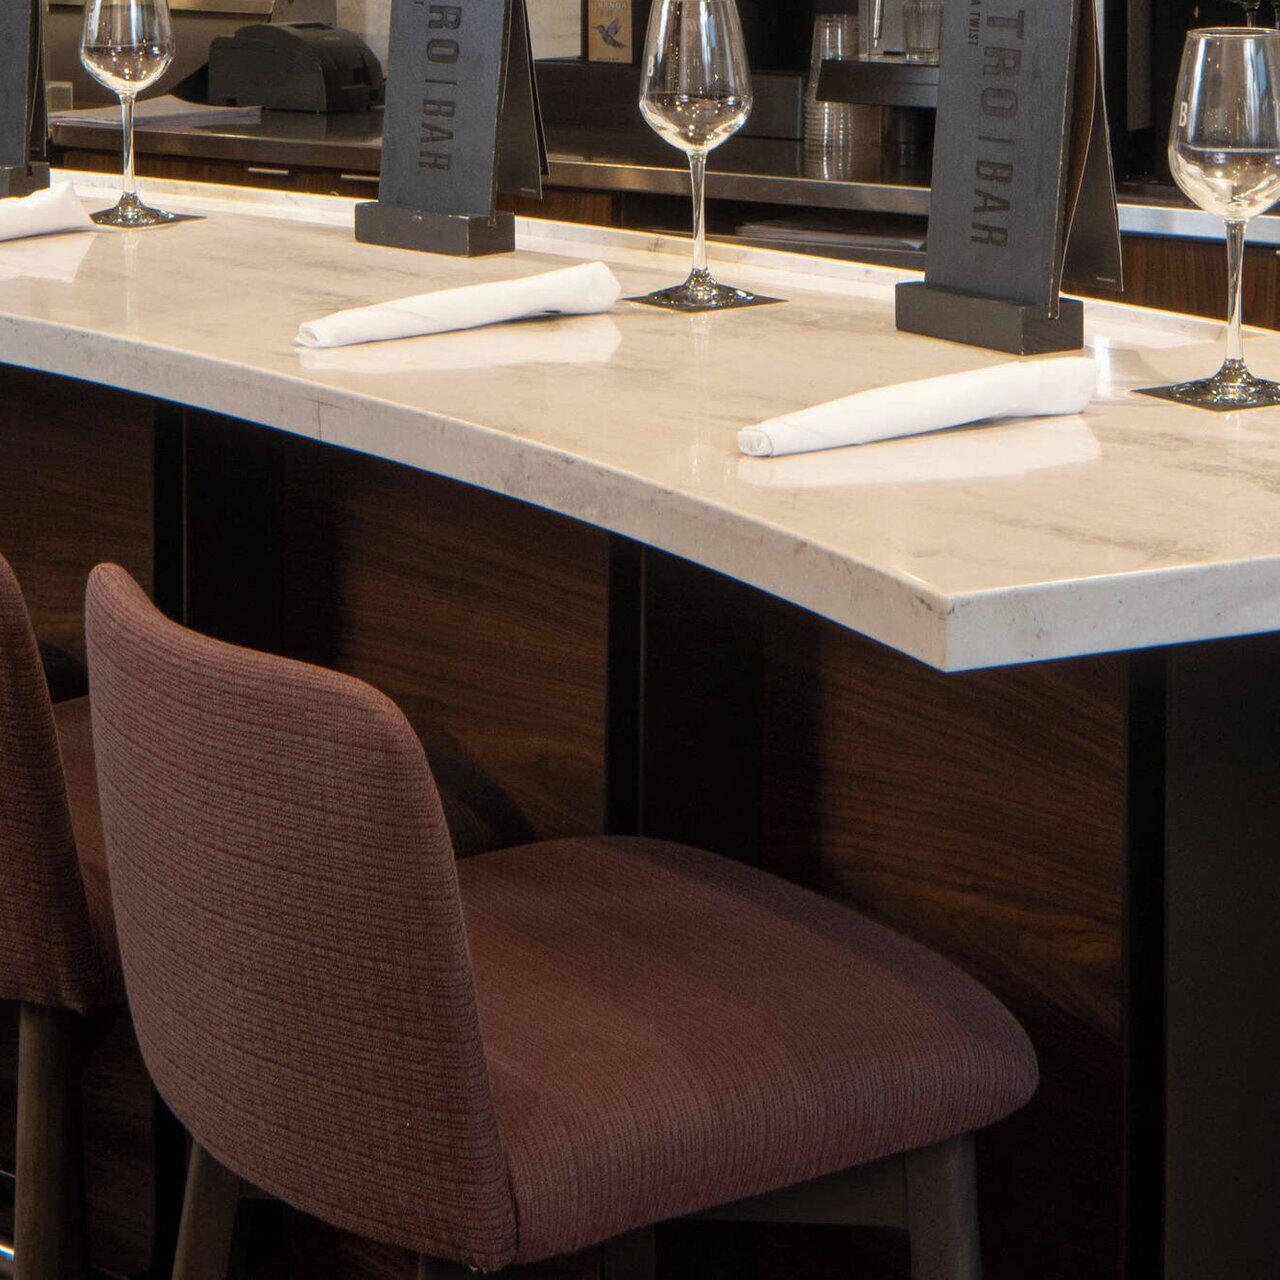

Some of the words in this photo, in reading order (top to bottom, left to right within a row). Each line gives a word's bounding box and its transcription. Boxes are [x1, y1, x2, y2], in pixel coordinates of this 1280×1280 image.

[967, 11, 981, 47] TWIST
[419, 99, 457, 173] BAR
[970, 158, 1014, 250] BAR
